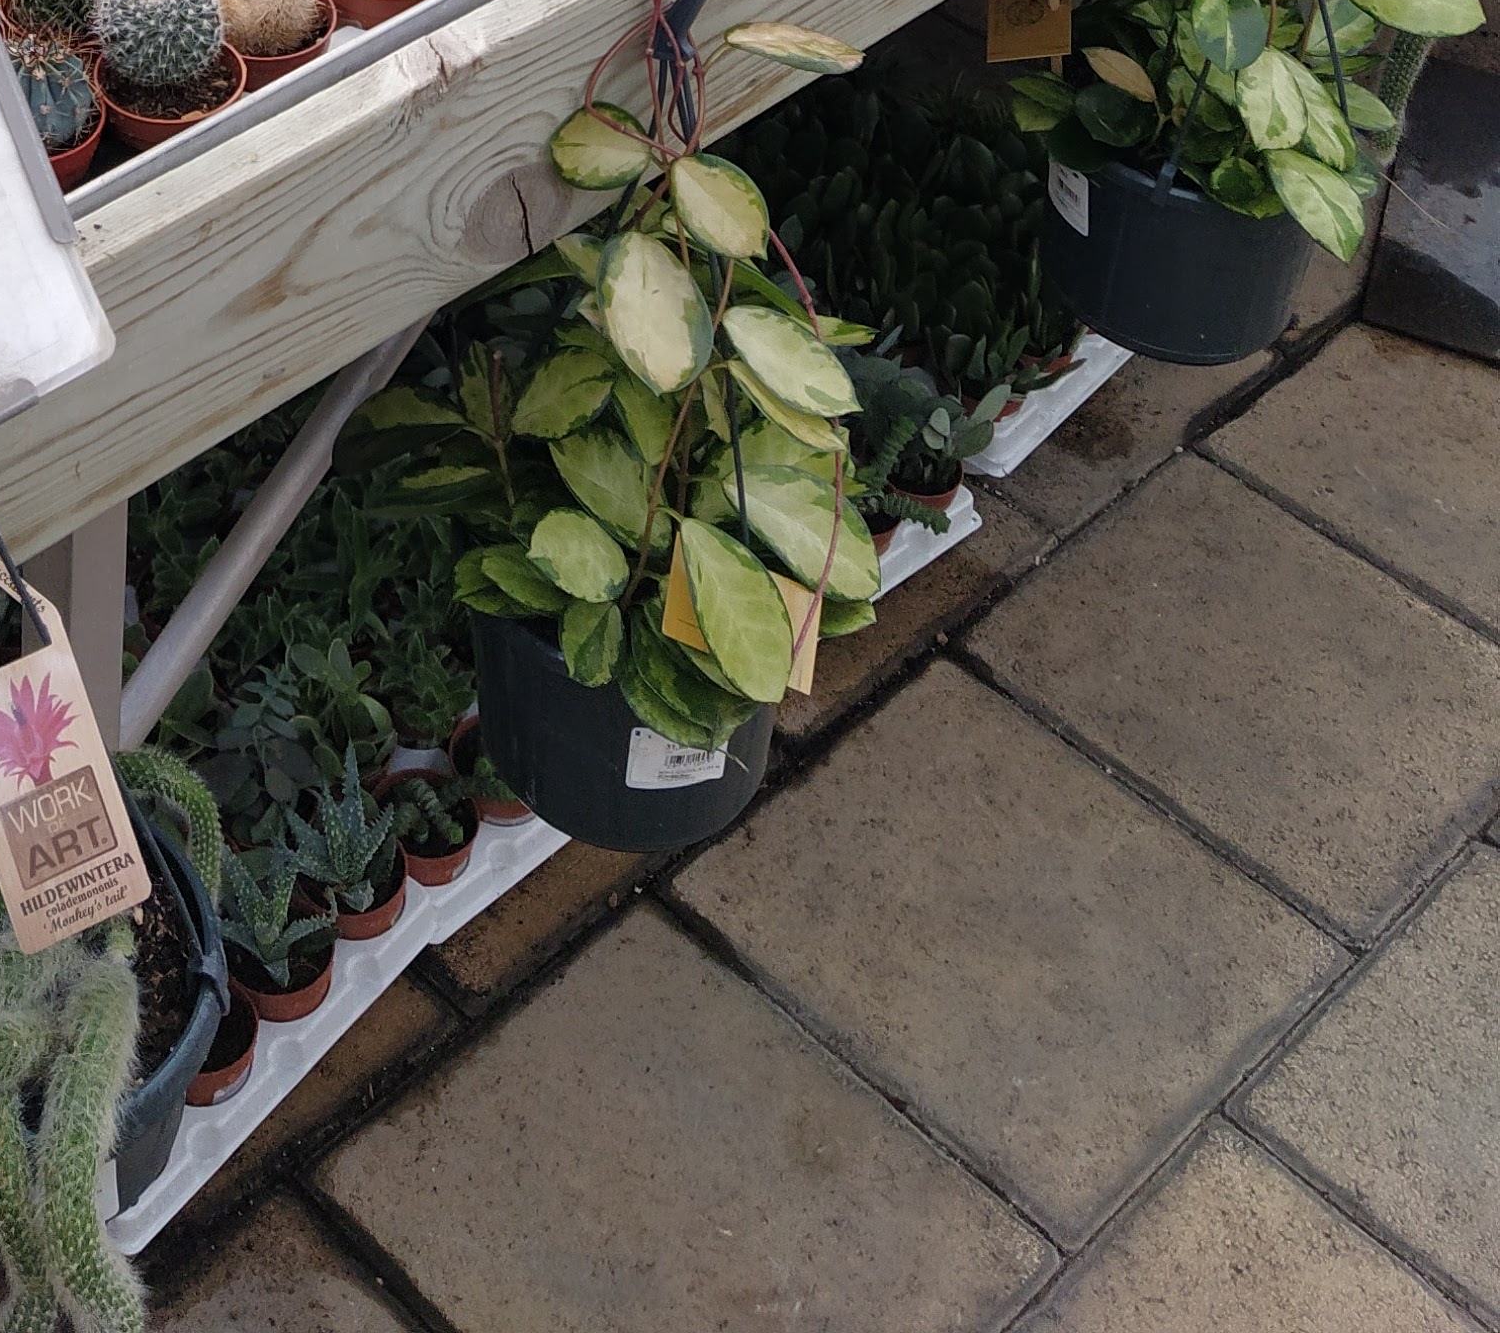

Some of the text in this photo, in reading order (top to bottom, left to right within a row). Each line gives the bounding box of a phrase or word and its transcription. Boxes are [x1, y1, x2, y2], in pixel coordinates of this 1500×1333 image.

[8, 776, 94, 834] WORK
[47, 816, 67, 834] OF
[20, 852, 136, 917] HILDEWINTERA
